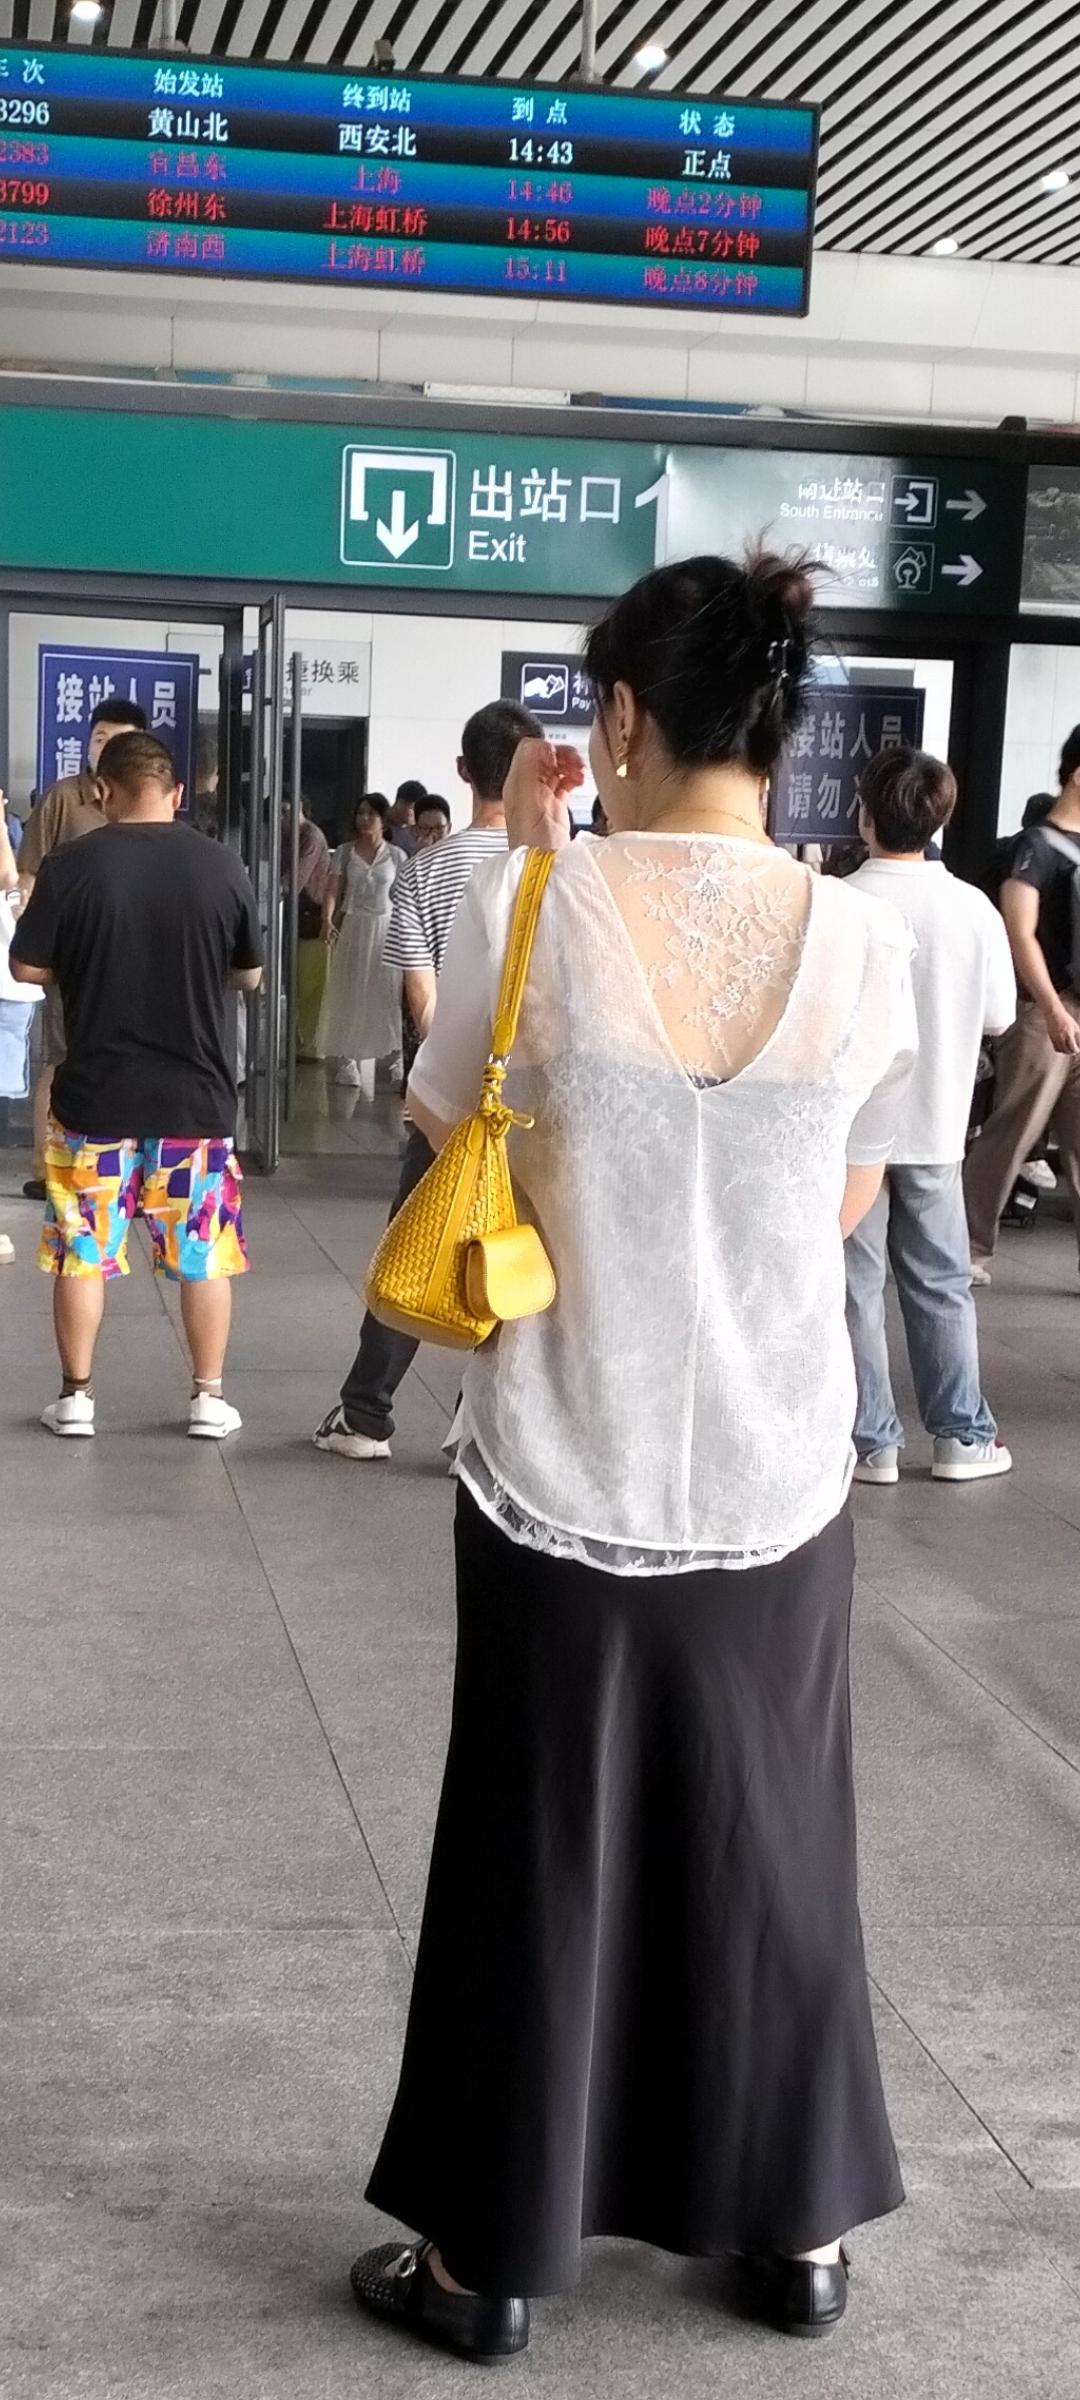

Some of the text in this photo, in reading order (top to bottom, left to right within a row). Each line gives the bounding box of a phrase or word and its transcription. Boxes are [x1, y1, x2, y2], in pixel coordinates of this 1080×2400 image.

[153, 68, 225, 98] 始发站
[342, 83, 413, 113] 终到站
[147, 107, 229, 142] 黄山北
[338, 123, 417, 156] 西安北
[149, 150, 227, 180] 宜昌东
[508, 137, 574, 165] 14:43
[681, 149, 732, 179] 正点
[352, 164, 402, 194] 上海
[508, 177, 573, 204] 14:46
[146, 188, 227, 221] 徐州东
[647, 186, 763, 219] 晚点2分钟
[323, 201, 428, 236] 上海虹桥
[506, 216, 572, 243] 14:56
[146, 231, 226, 260] 济南西
[645, 225, 761, 259] 晚点7分钟
[321, 241, 426, 275] 上海虹桥
[504, 256, 567, 283] 15:11
[469, 464, 622, 523] 出站口
[779, 502, 820, 519] South
[468, 530, 527, 563] Exit
